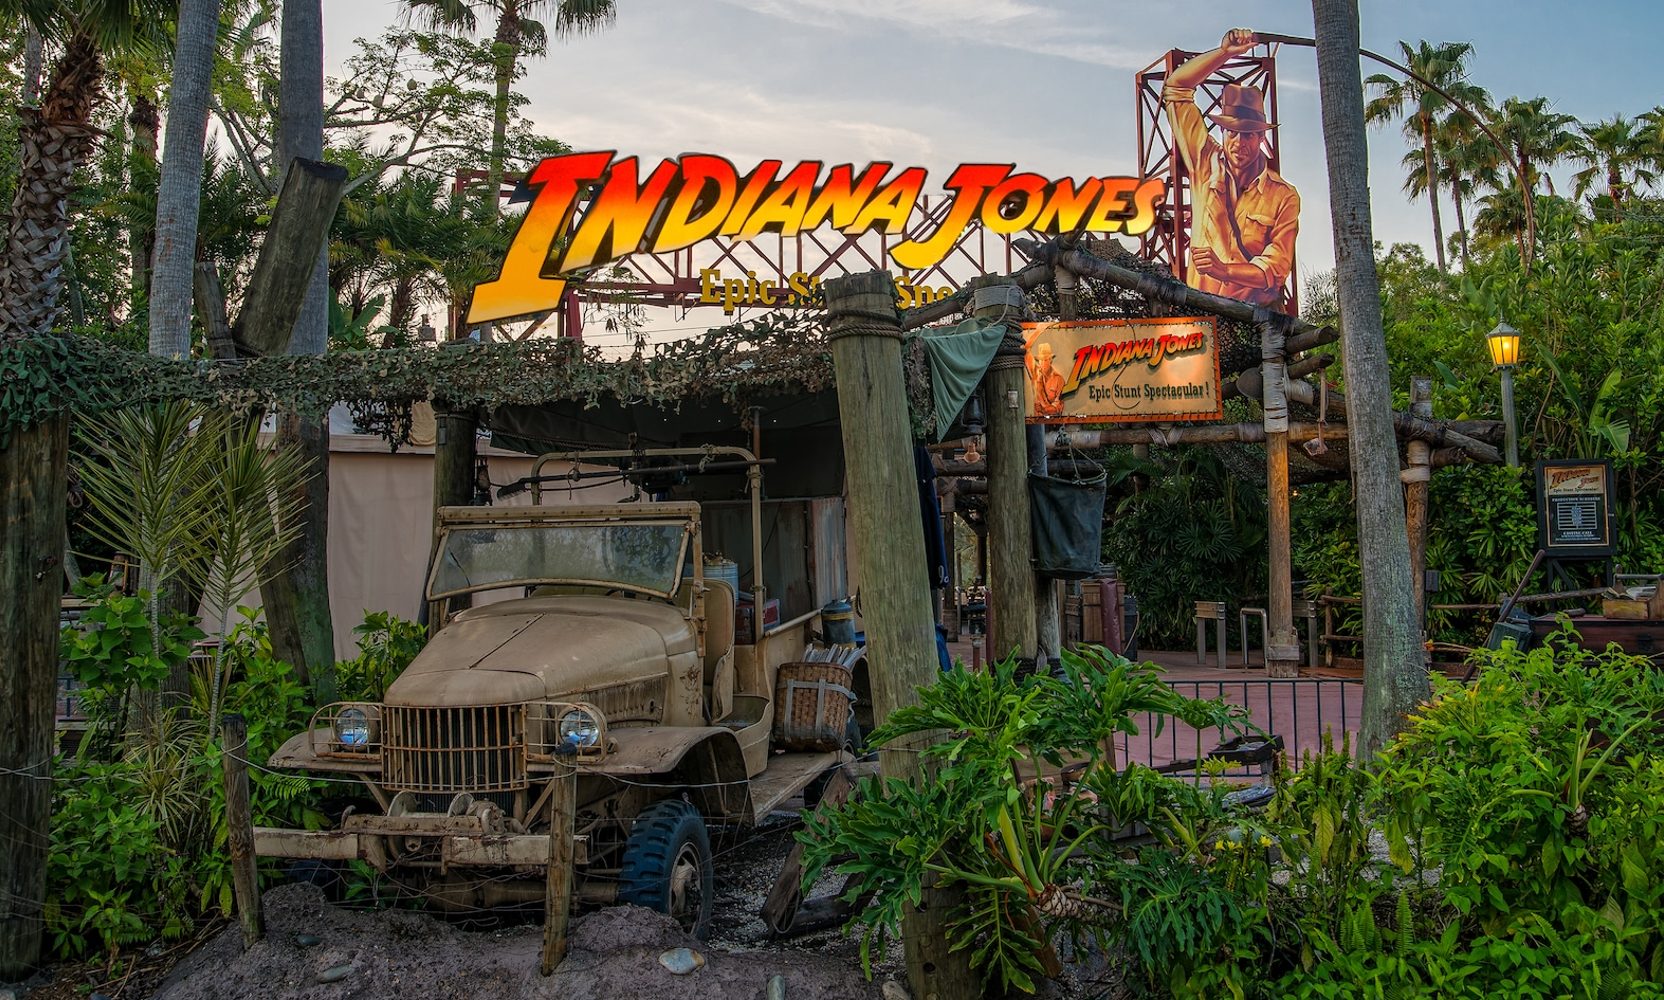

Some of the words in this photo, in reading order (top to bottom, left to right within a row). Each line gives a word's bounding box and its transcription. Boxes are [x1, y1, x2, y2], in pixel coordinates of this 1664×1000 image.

[466, 149, 930, 325] INDIANA
[891, 162, 1165, 271] JONES
[699, 268, 777, 313] Epic
[1061, 337, 1159, 395] INDIANA
[1147, 331, 1205, 367] JONES
[1088, 384, 1111, 403] Epic
[1113, 383, 1142, 399] Stunt
